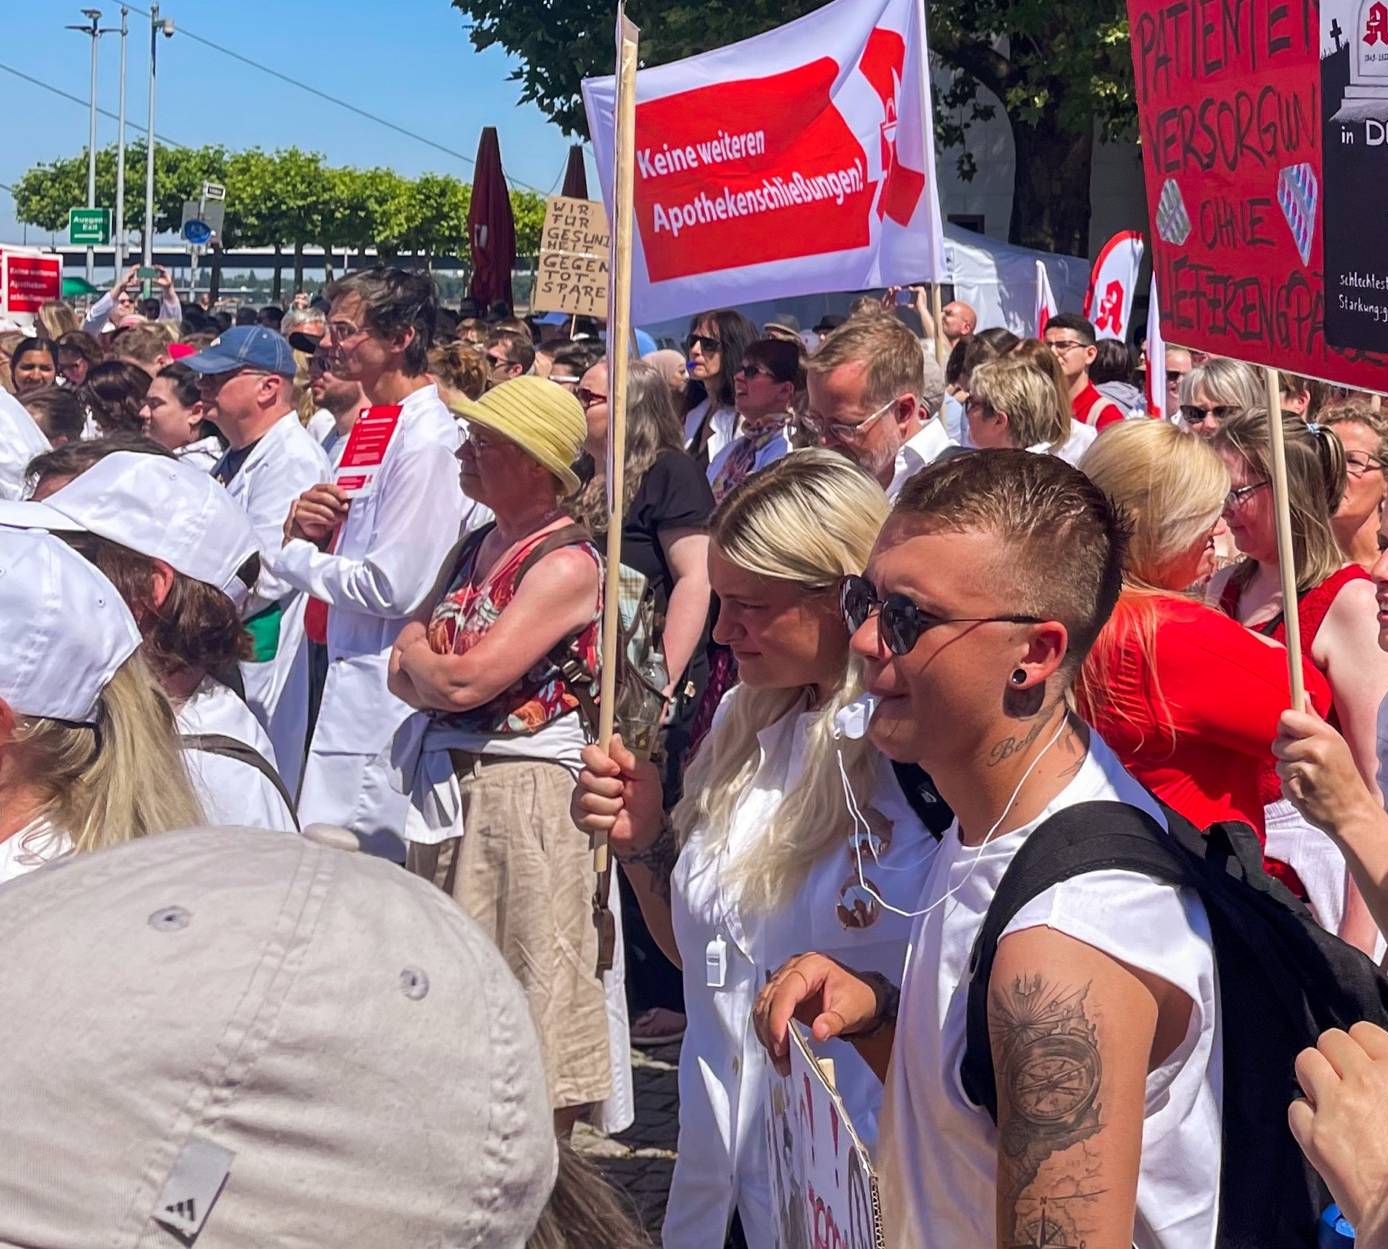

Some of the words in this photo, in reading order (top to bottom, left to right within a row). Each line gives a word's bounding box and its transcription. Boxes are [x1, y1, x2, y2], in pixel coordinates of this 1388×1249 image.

[1341, 126, 1354, 145] in
[637, 143, 699, 180] Keine
[696, 129, 766, 165] weiteren
[553, 202, 589, 216] WIR
[653, 158, 864, 238] Apothekenschließungen!
[1201, 198, 1276, 249] OHNE
[544, 270, 596, 283] TOT-
